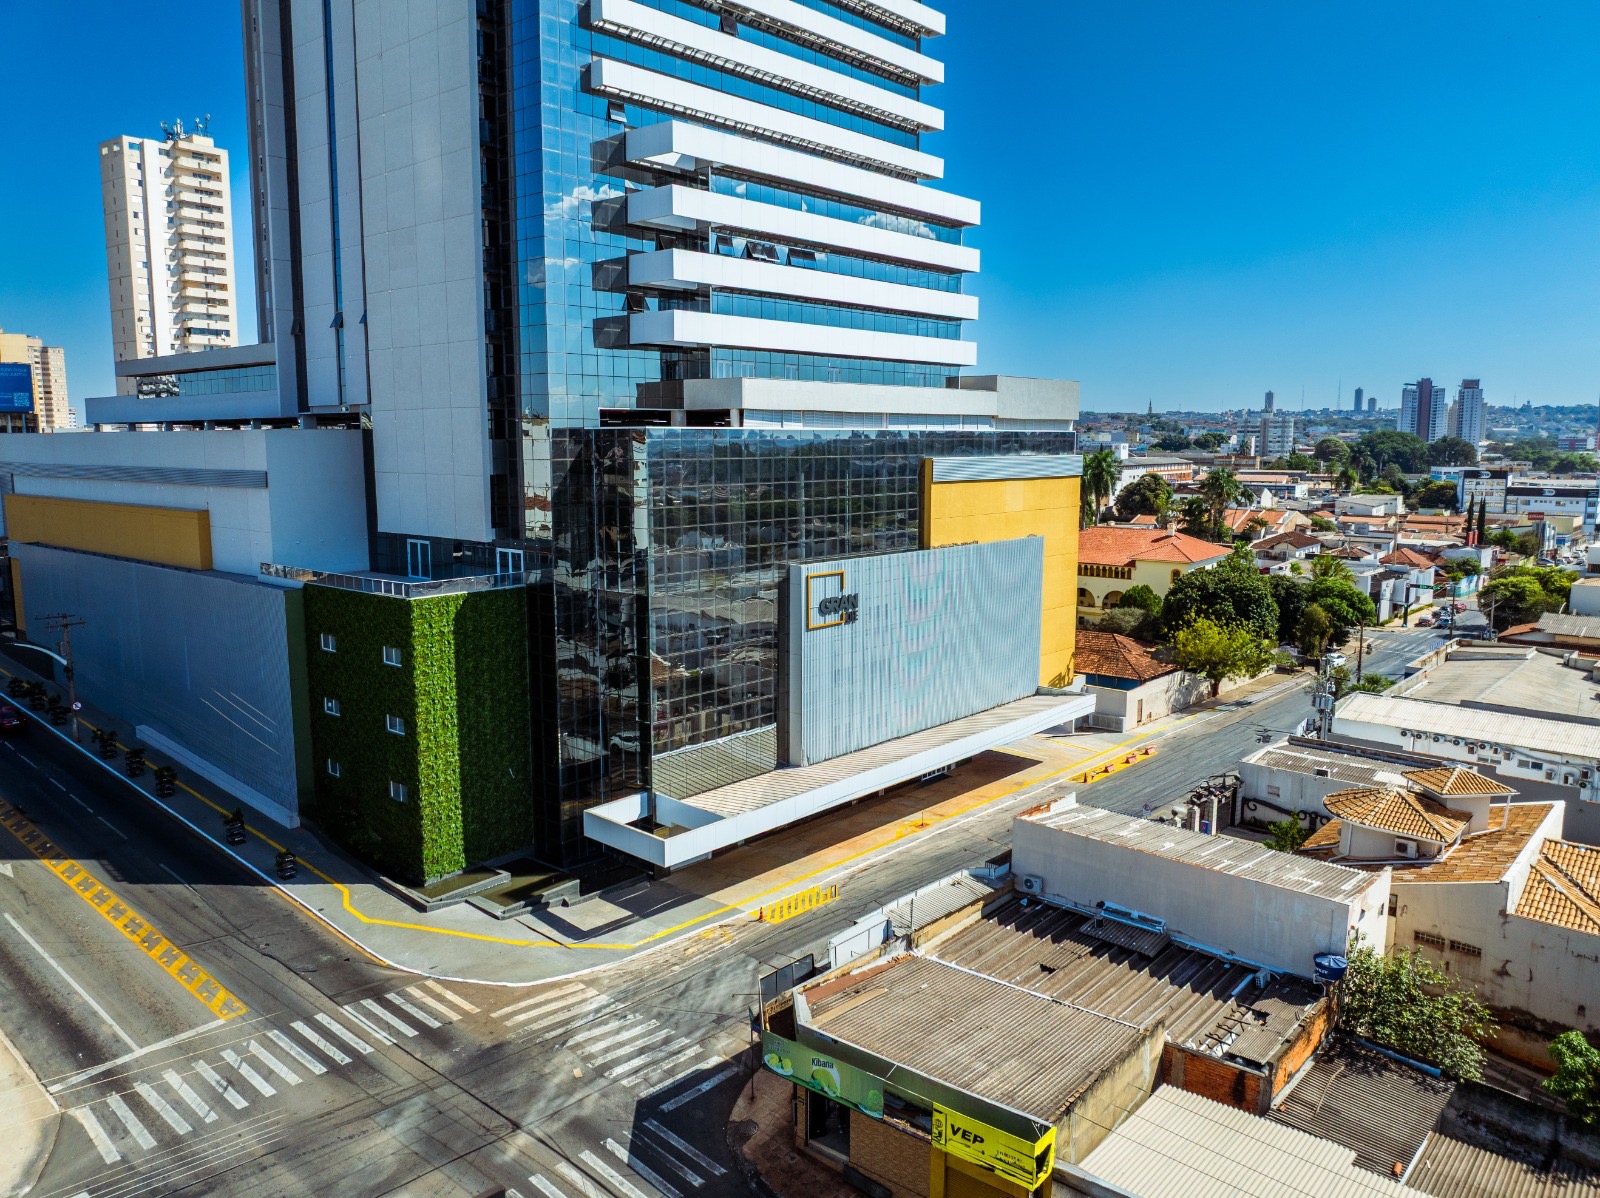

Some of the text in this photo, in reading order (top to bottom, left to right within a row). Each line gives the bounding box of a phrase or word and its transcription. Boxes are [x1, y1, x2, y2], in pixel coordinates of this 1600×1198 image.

[819, 593, 859, 616] GRAN
[812, 1057, 834, 1069] Kibana
[950, 1123, 985, 1145] VEP
